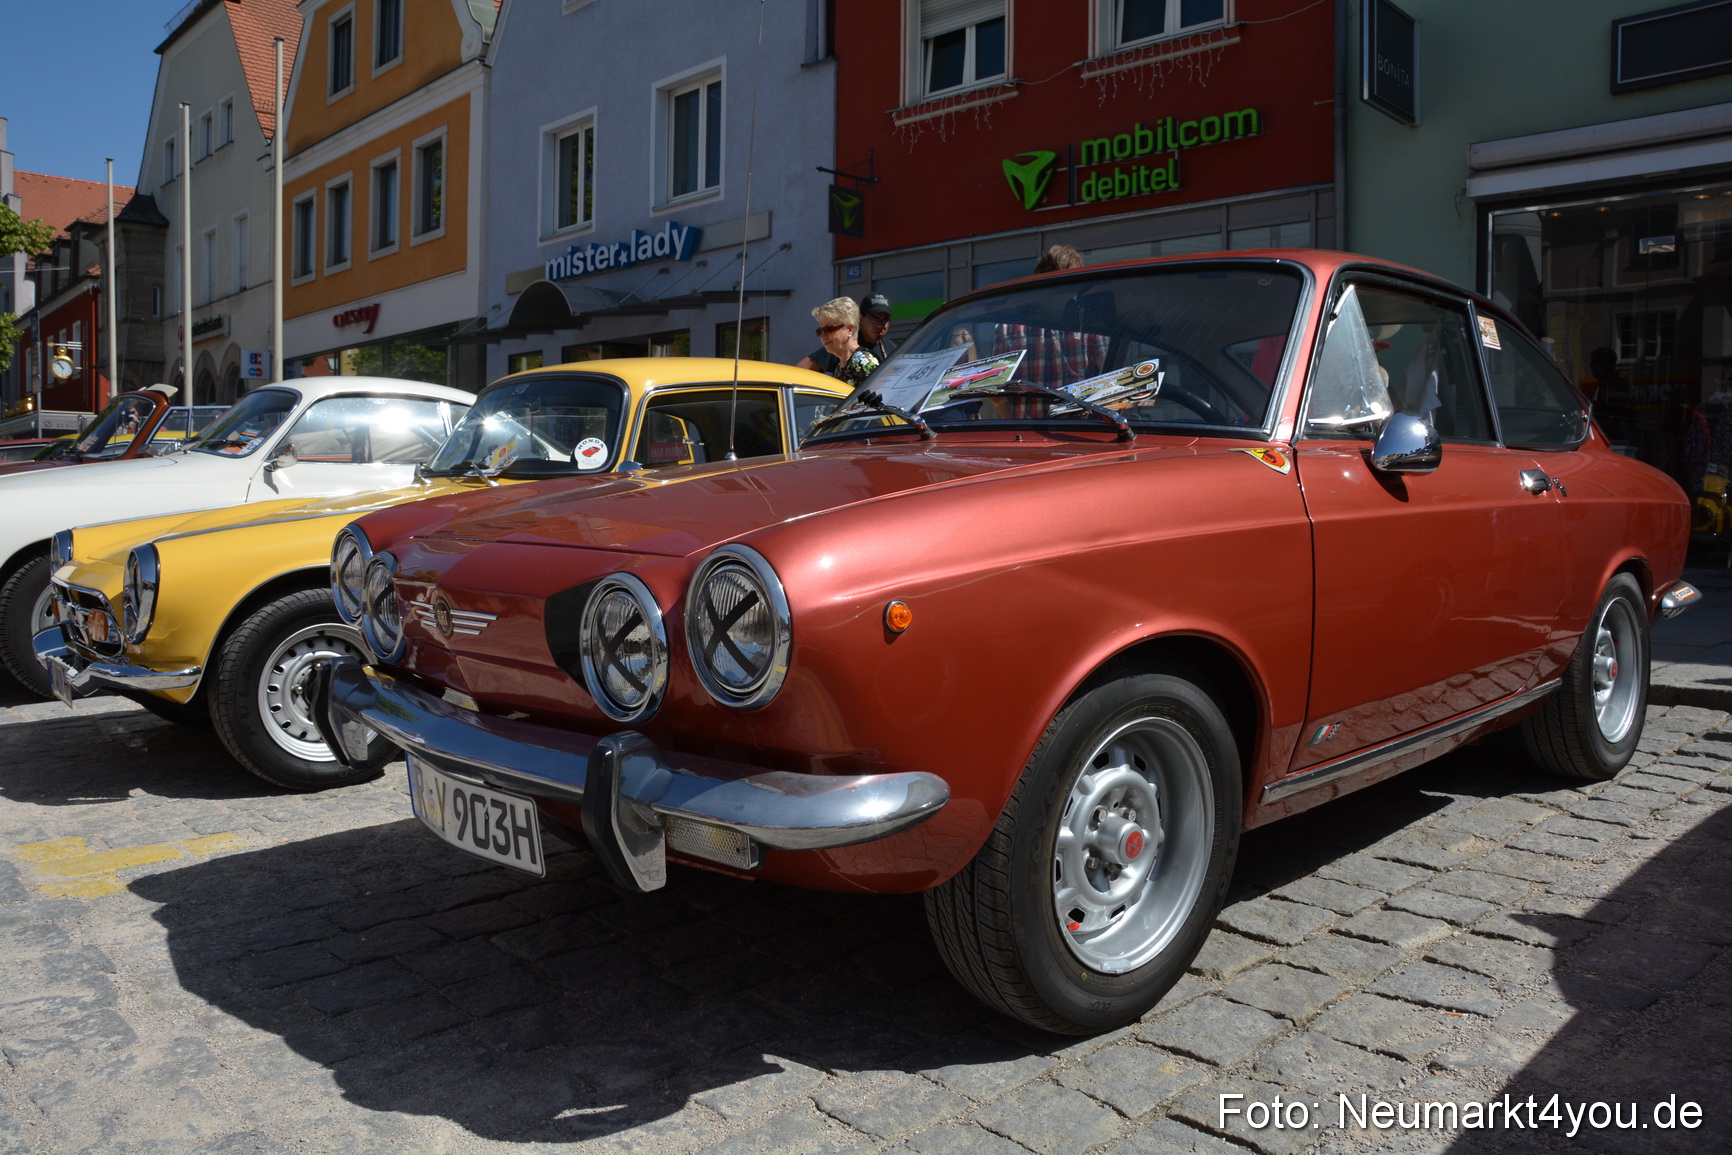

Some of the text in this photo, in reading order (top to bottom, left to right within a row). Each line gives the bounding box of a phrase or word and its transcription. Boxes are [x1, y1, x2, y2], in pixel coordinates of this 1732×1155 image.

[1377, 54, 1410, 88] BONITA
[1080, 108, 1259, 166] mobilcom
[1081, 158, 1181, 203] debitel
[545, 220, 690, 281] mister lady
[848, 266, 860, 277] 45
[906, 363, 939, 382] 481
[577, 438, 604, 450] HONDA
[453, 788, 538, 865] 903H
